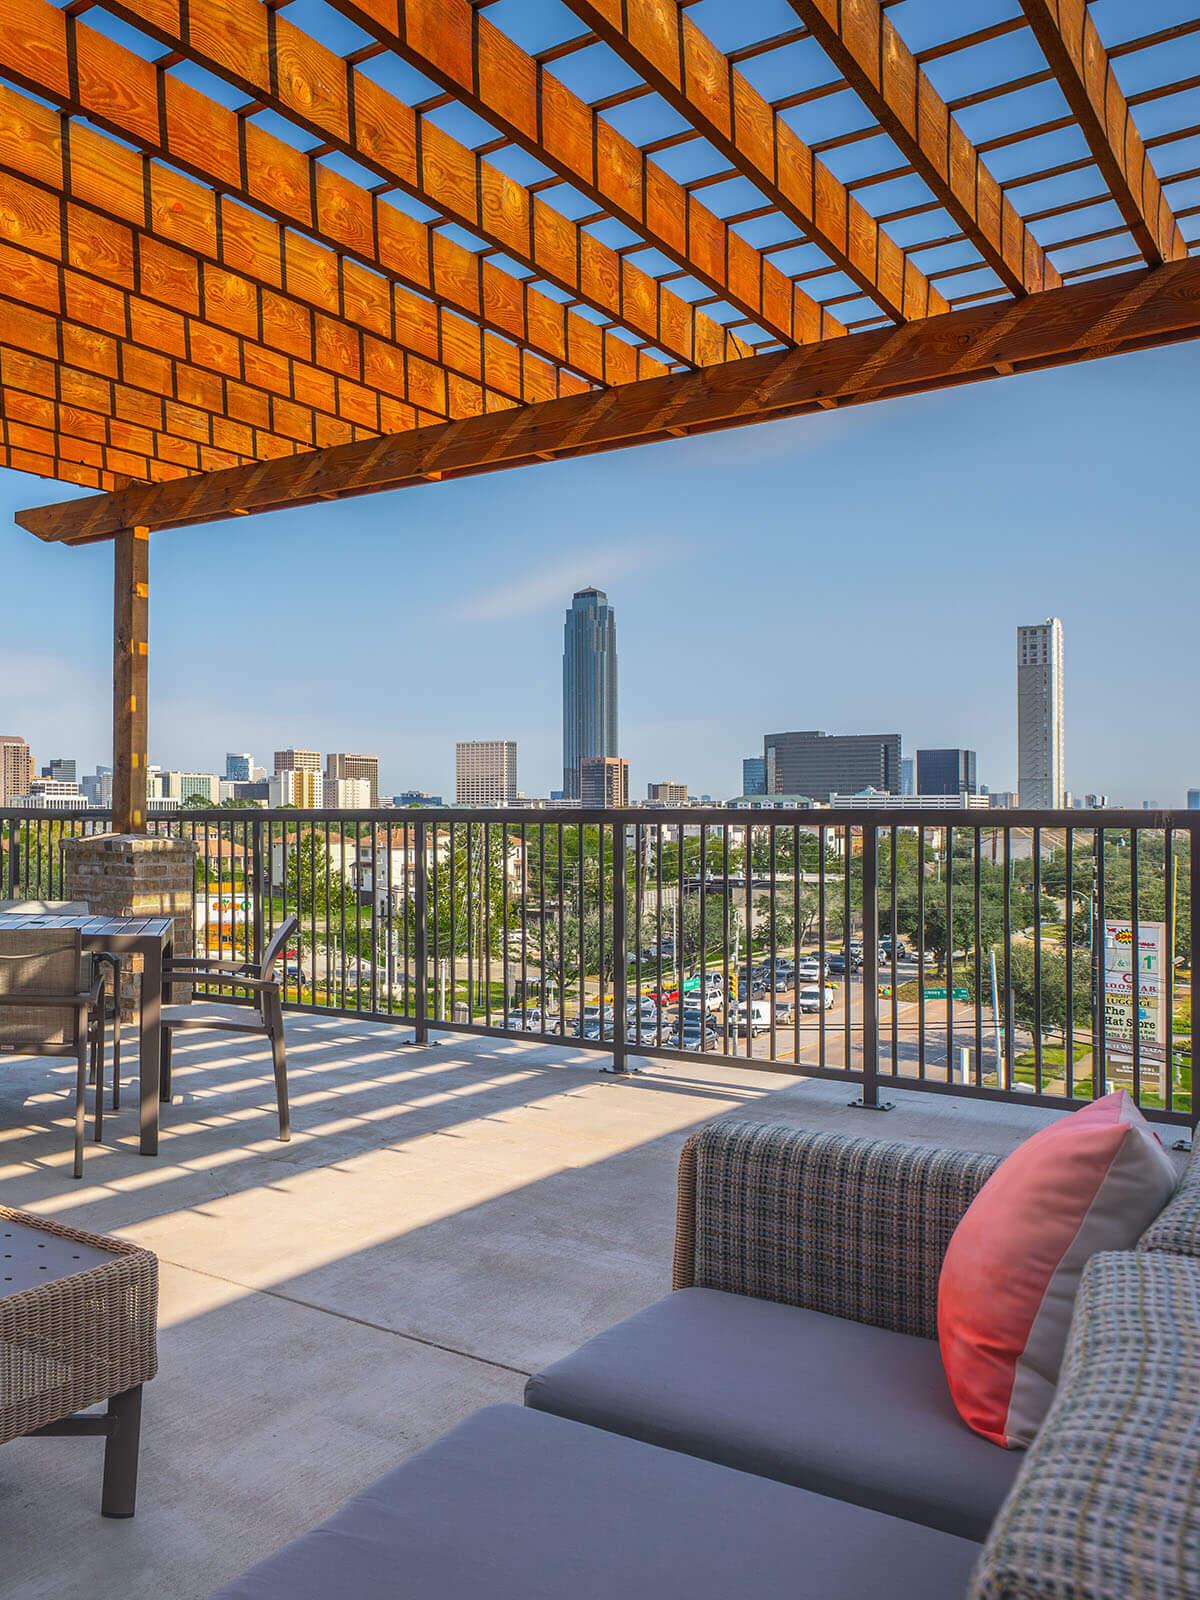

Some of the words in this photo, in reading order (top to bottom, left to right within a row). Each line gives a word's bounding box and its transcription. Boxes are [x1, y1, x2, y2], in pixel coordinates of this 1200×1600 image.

[1106, 997, 1152, 1008] LUGGGE
[1105, 1006, 1125, 1015] The
[1105, 1016, 1124, 1025] Hat
[1126, 1018, 1156, 1028] Sore
